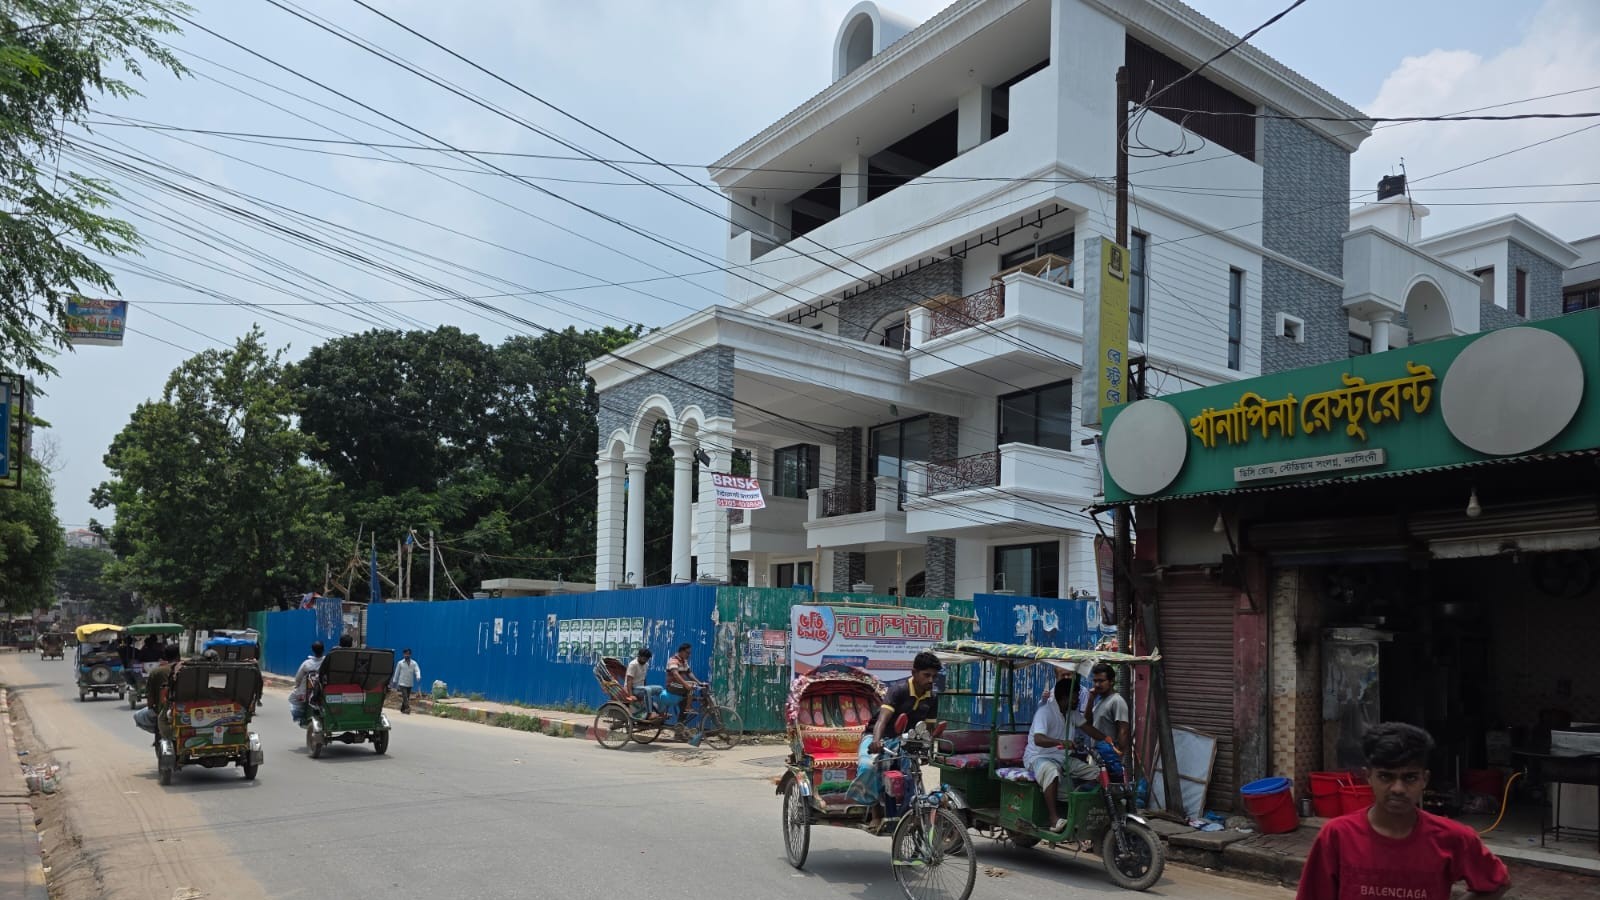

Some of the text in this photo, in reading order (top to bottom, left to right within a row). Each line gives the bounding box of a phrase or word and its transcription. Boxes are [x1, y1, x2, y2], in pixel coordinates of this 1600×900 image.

[1190, 361, 1437, 447] খানাপিনা রেস্টুরেন্ট
[712, 473, 759, 489] BRISK
[865, 614, 945, 640] কম্পিউটার
[1360, 885, 1427, 899] BALENCIAGA
